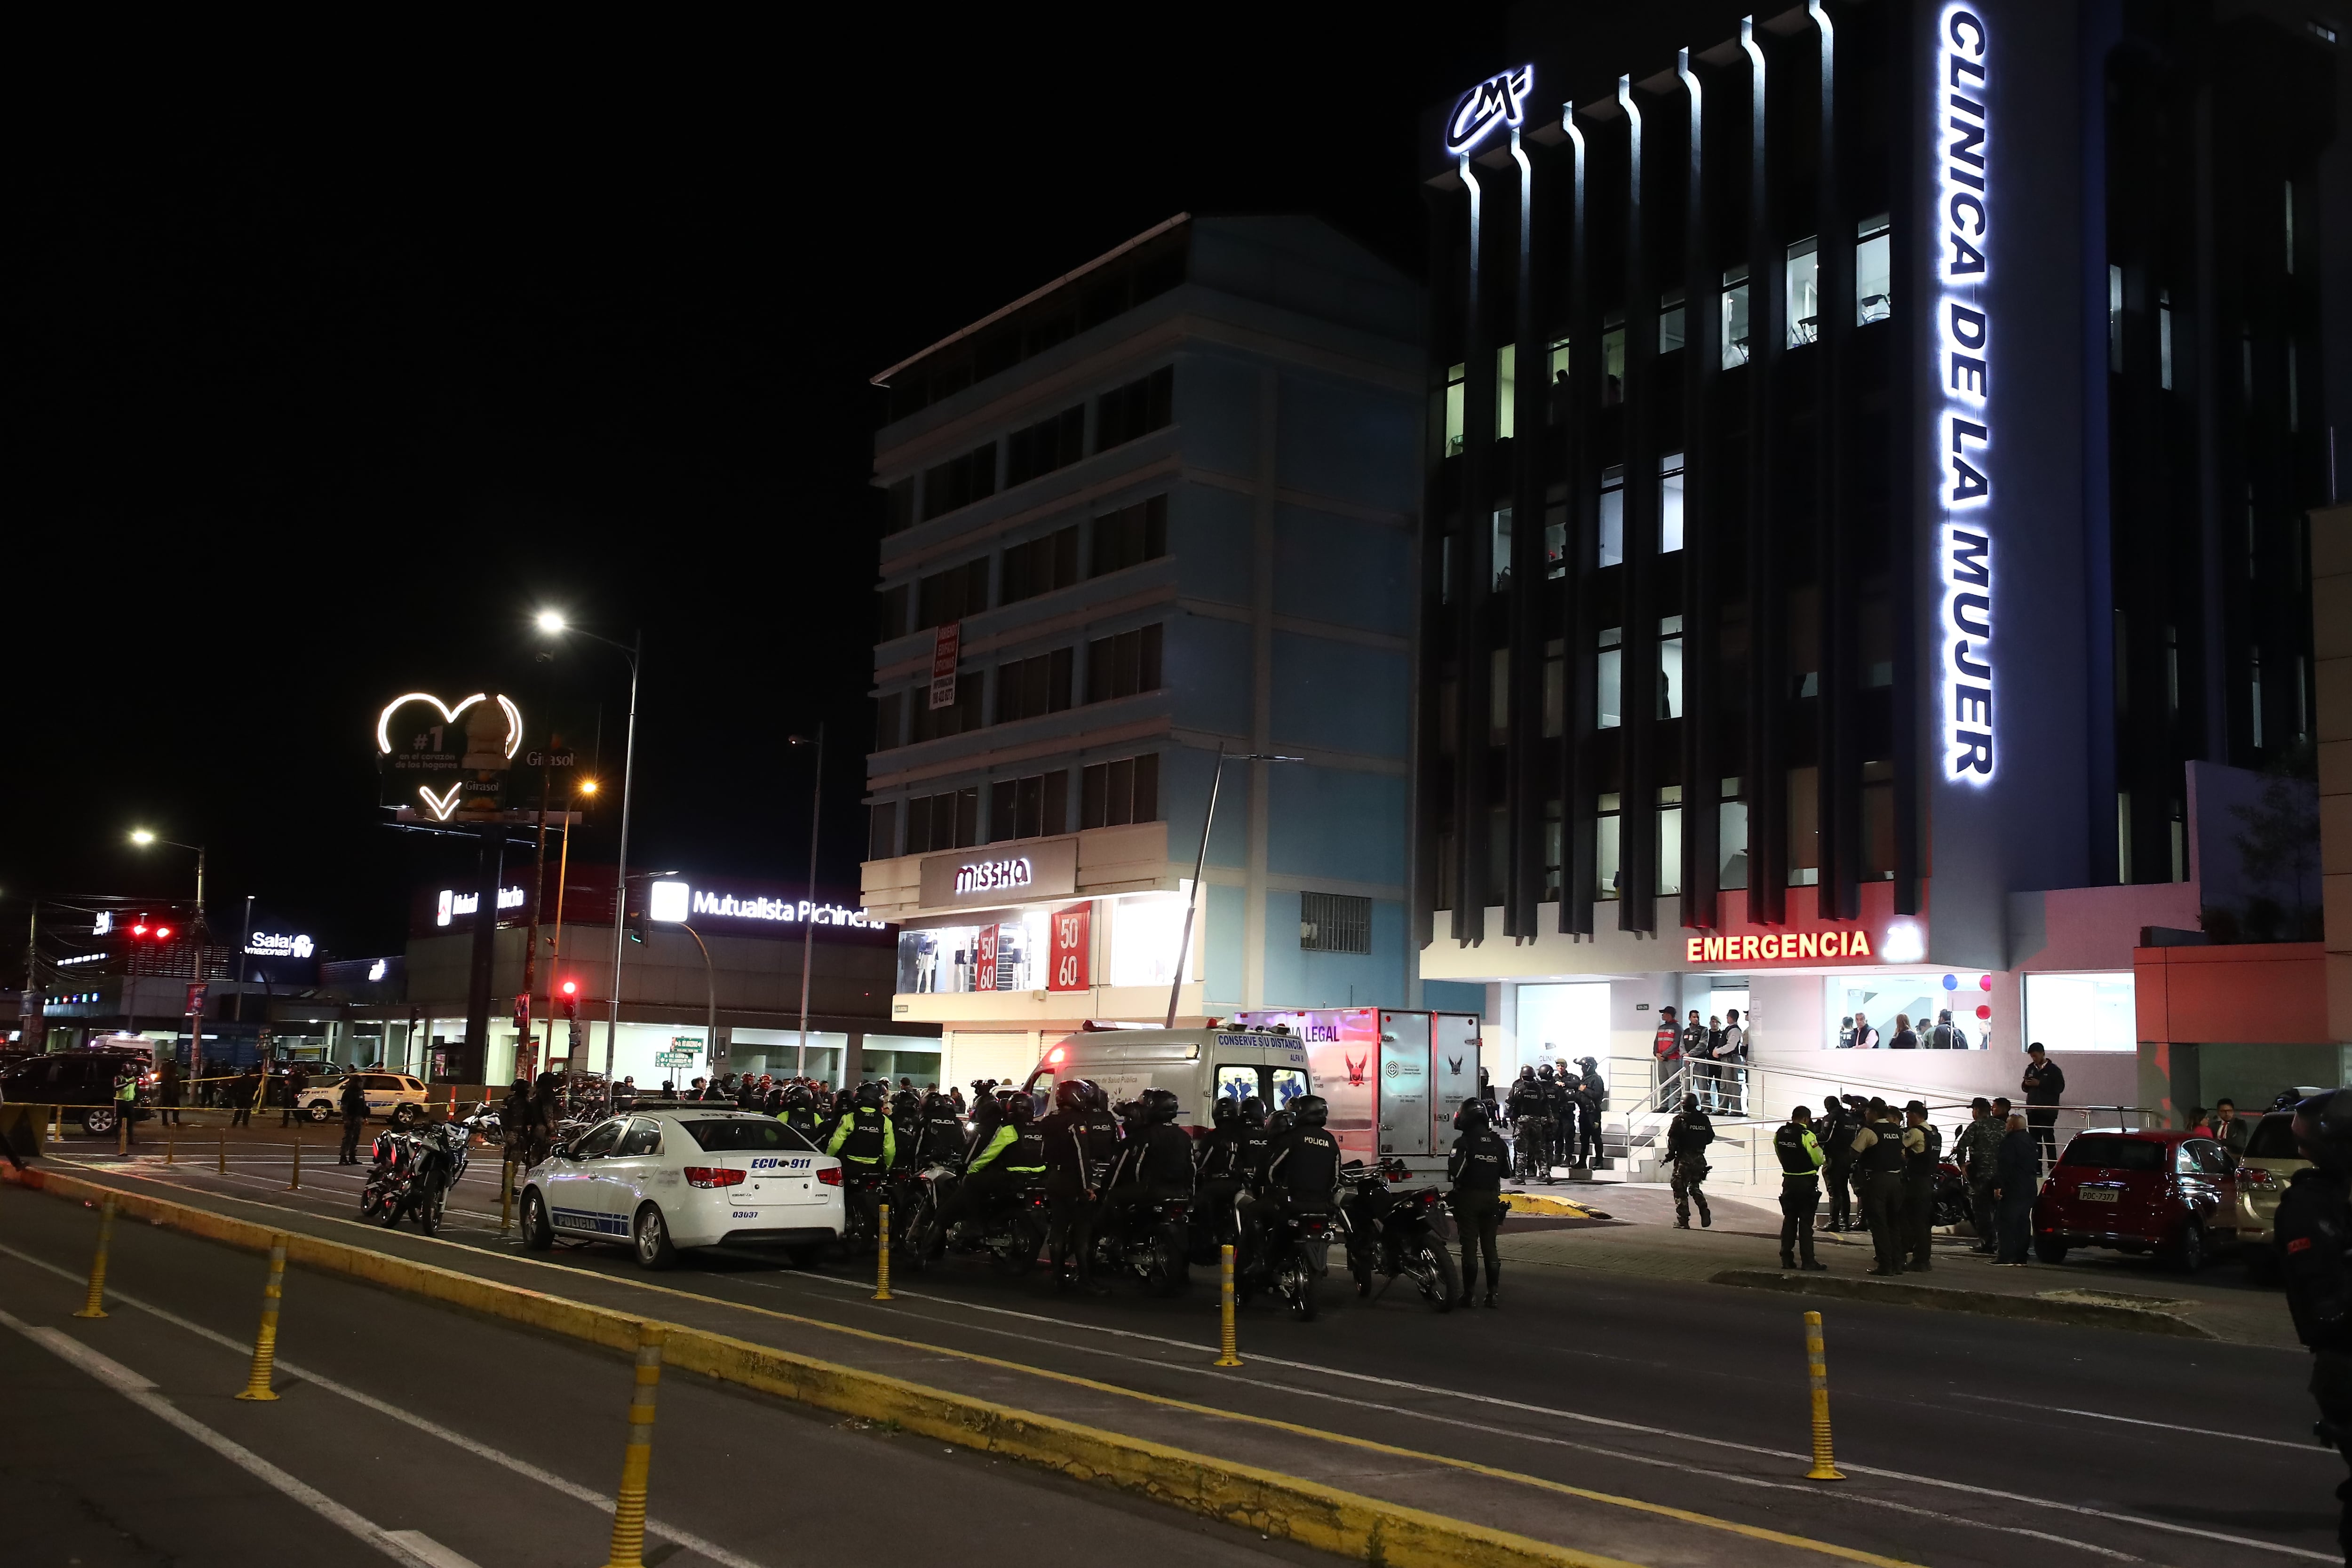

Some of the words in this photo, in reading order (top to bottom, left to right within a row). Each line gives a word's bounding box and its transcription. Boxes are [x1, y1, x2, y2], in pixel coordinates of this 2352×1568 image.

[1948, 9, 1986, 277] CLINICA
[1950, 302, 1987, 399] DE
[1951, 417, 1988, 501] LA
[1952, 528, 1993, 775] MUJER
[423, 761, 458, 771] hogares
[465, 780, 499, 792] Girasol
[693, 891, 795, 921] Mutualista
[252, 931, 289, 948] Sala
[1060, 918, 1078, 949] 50
[981, 936, 994, 961] 50
[1687, 930, 1871, 962] EMERGENCIA
[980, 965, 993, 989] 60
[1059, 955, 1077, 986] 60
[1218, 1035, 1257, 1047] CONSERVE
[1271, 1037, 1303, 1051] DISTANCIA
[1305, 1026, 1340, 1042] LEGAL
[1304, 1136, 1329, 1147] POLICIA
[751, 1158, 778, 1169] ECU
[790, 1158, 811, 1169] 911
[2082, 1192, 2114, 1201] PDC-7377
[558, 1216, 597, 1230] POLICIA
